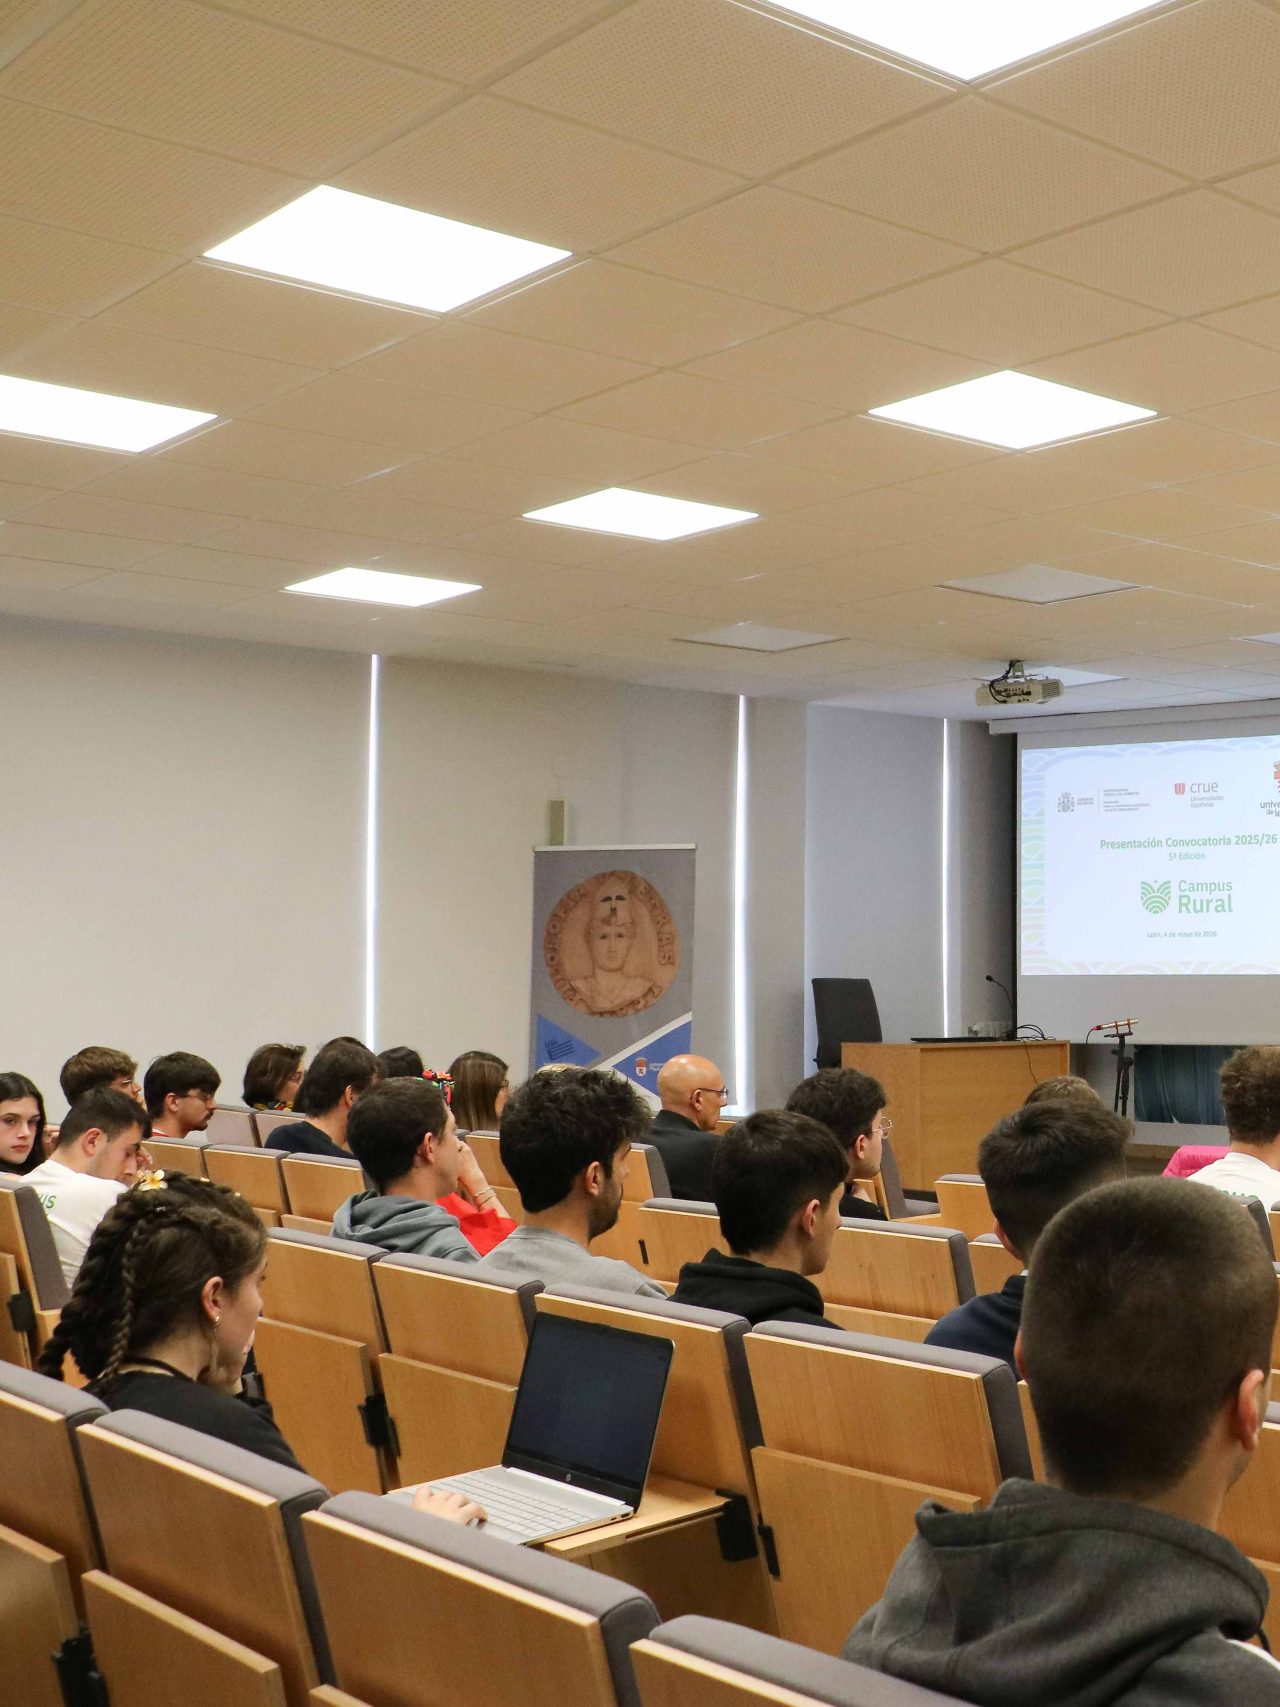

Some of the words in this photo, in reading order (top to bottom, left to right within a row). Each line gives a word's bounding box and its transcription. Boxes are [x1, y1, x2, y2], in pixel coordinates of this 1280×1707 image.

[1190, 782, 1219, 794] crue
[1100, 837, 1163, 850] Presentación
[1165, 835, 1232, 848] Convocatoria
[1234, 833, 1278, 846] 2025/26
[1178, 851, 1206, 861] Edición
[1178, 880, 1233, 895] Campus
[1178, 894, 1234, 914] Rural
